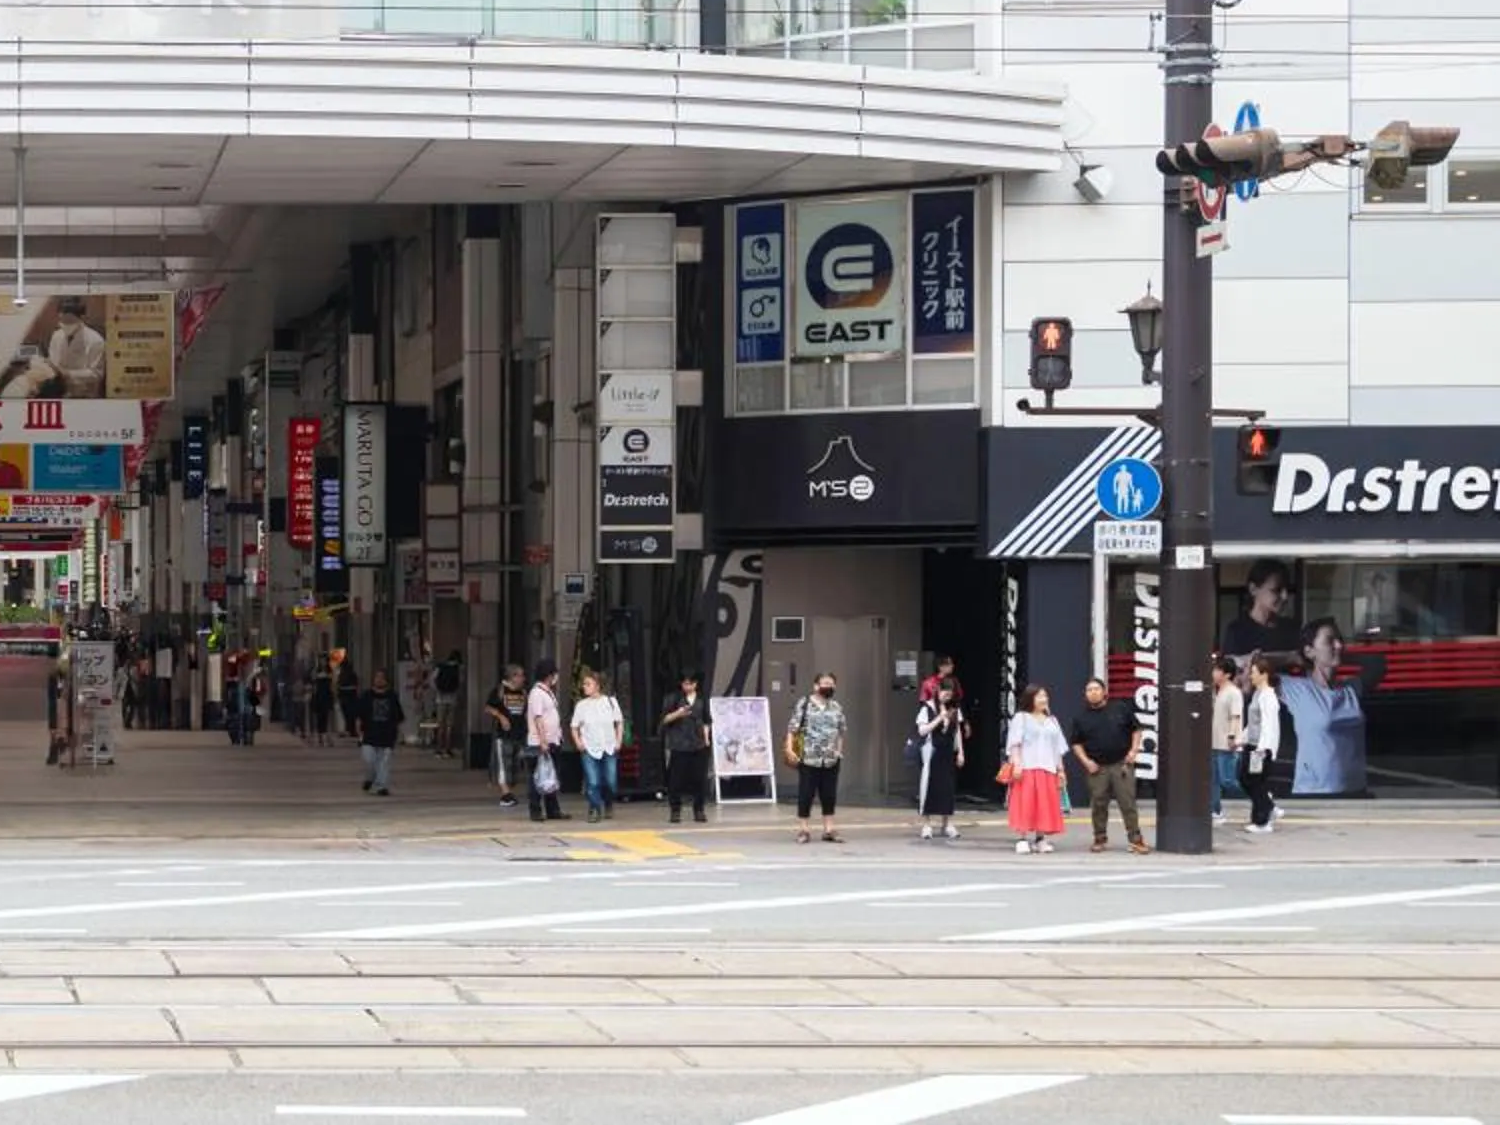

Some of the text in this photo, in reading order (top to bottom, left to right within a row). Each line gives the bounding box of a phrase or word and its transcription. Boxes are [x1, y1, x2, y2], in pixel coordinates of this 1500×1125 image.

[921, 232, 940, 320] クリニック
[944, 215, 966, 331] イースト駅前
[804, 318, 894, 344] EAST
[187, 426, 202, 482] LIFE
[356, 407, 374, 527] MARUTA GO
[603, 492, 669, 507] Dr.stretch
